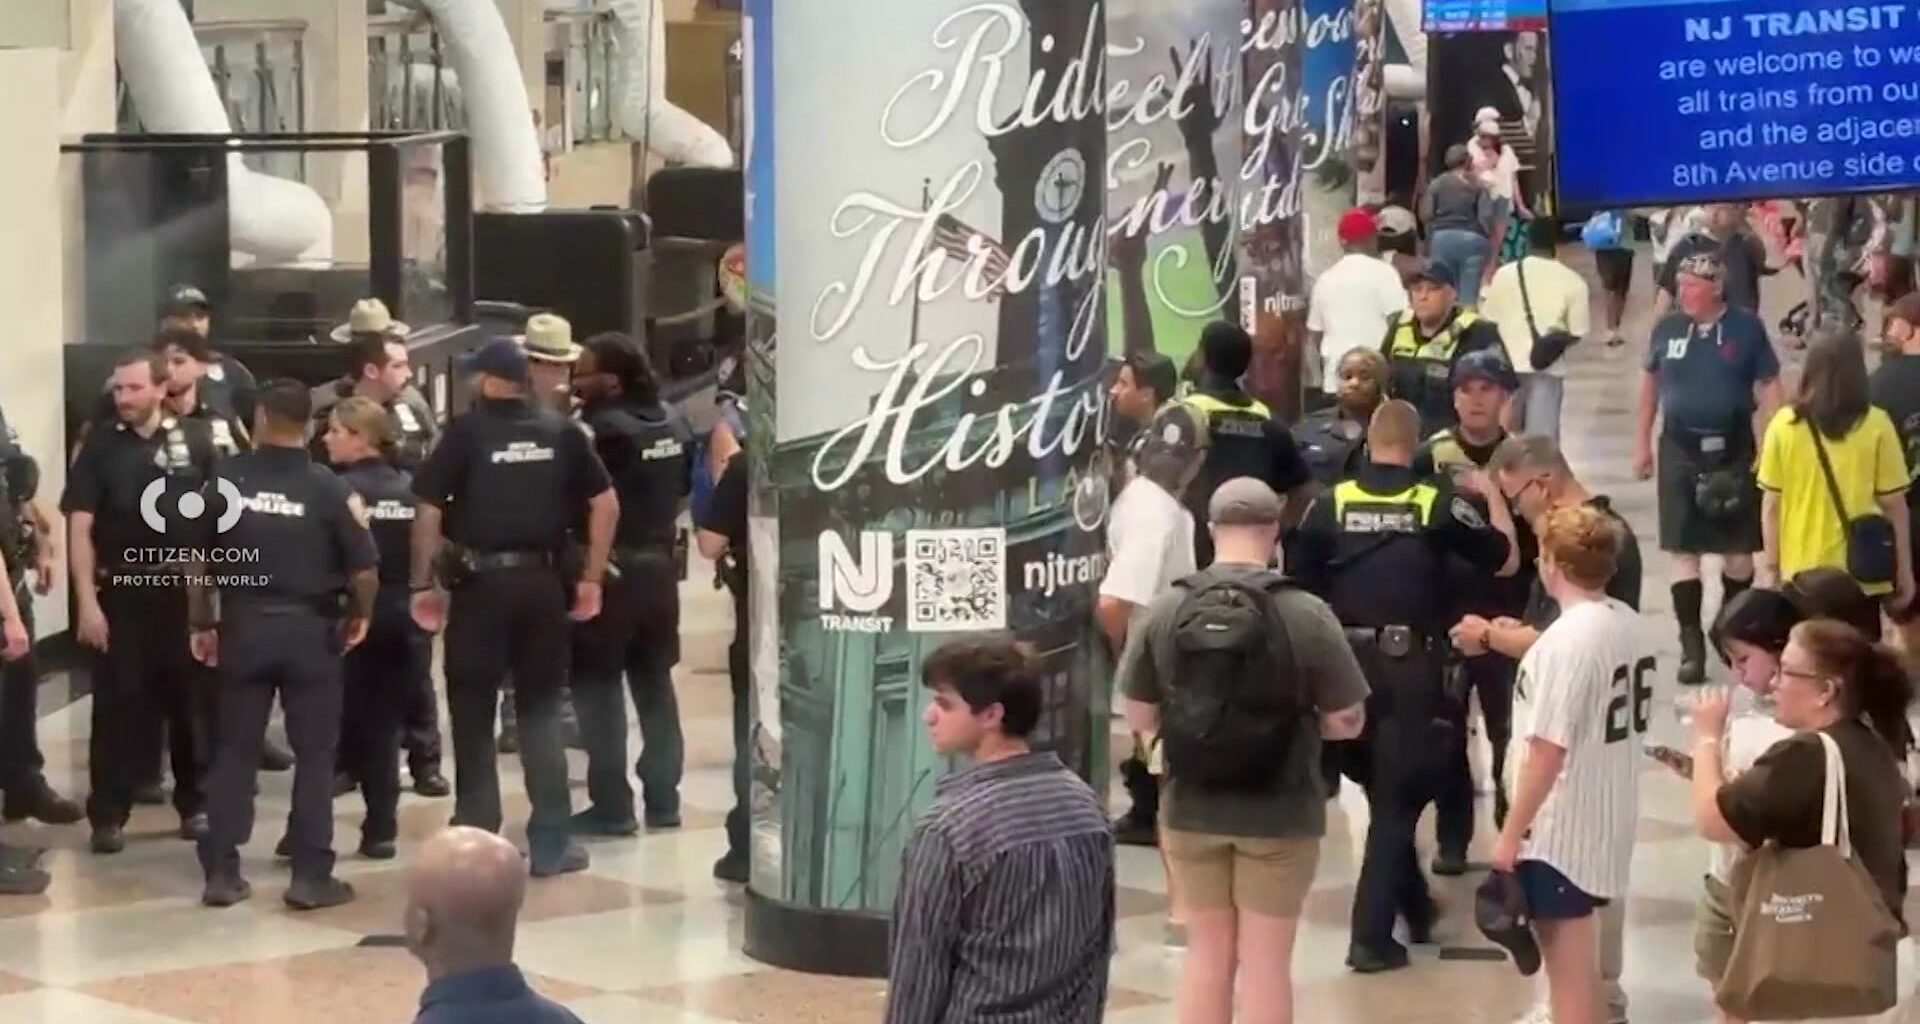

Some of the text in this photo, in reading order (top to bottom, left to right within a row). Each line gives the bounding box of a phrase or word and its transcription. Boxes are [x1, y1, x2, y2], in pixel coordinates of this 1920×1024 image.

[1684, 5, 1906, 42] NJ TRANSIT
[1659, 59, 1707, 80] are
[1714, 50, 1844, 77] welcome
[1853, 44, 1881, 67] to
[1106, 32, 1210, 131] eel
[1677, 89, 1711, 115] all
[1718, 87, 1799, 112] trains
[1808, 82, 1874, 106] from
[1699, 124, 1753, 150] and
[1762, 121, 1808, 146] the
[1673, 162, 1718, 188] 8th
[1724, 160, 1835, 184] Avenue
[1844, 152, 1905, 177] side
[1666, 338, 1688, 359] 10
[820, 614, 894, 633] TRANSIT
[1604, 655, 1658, 745] 26
